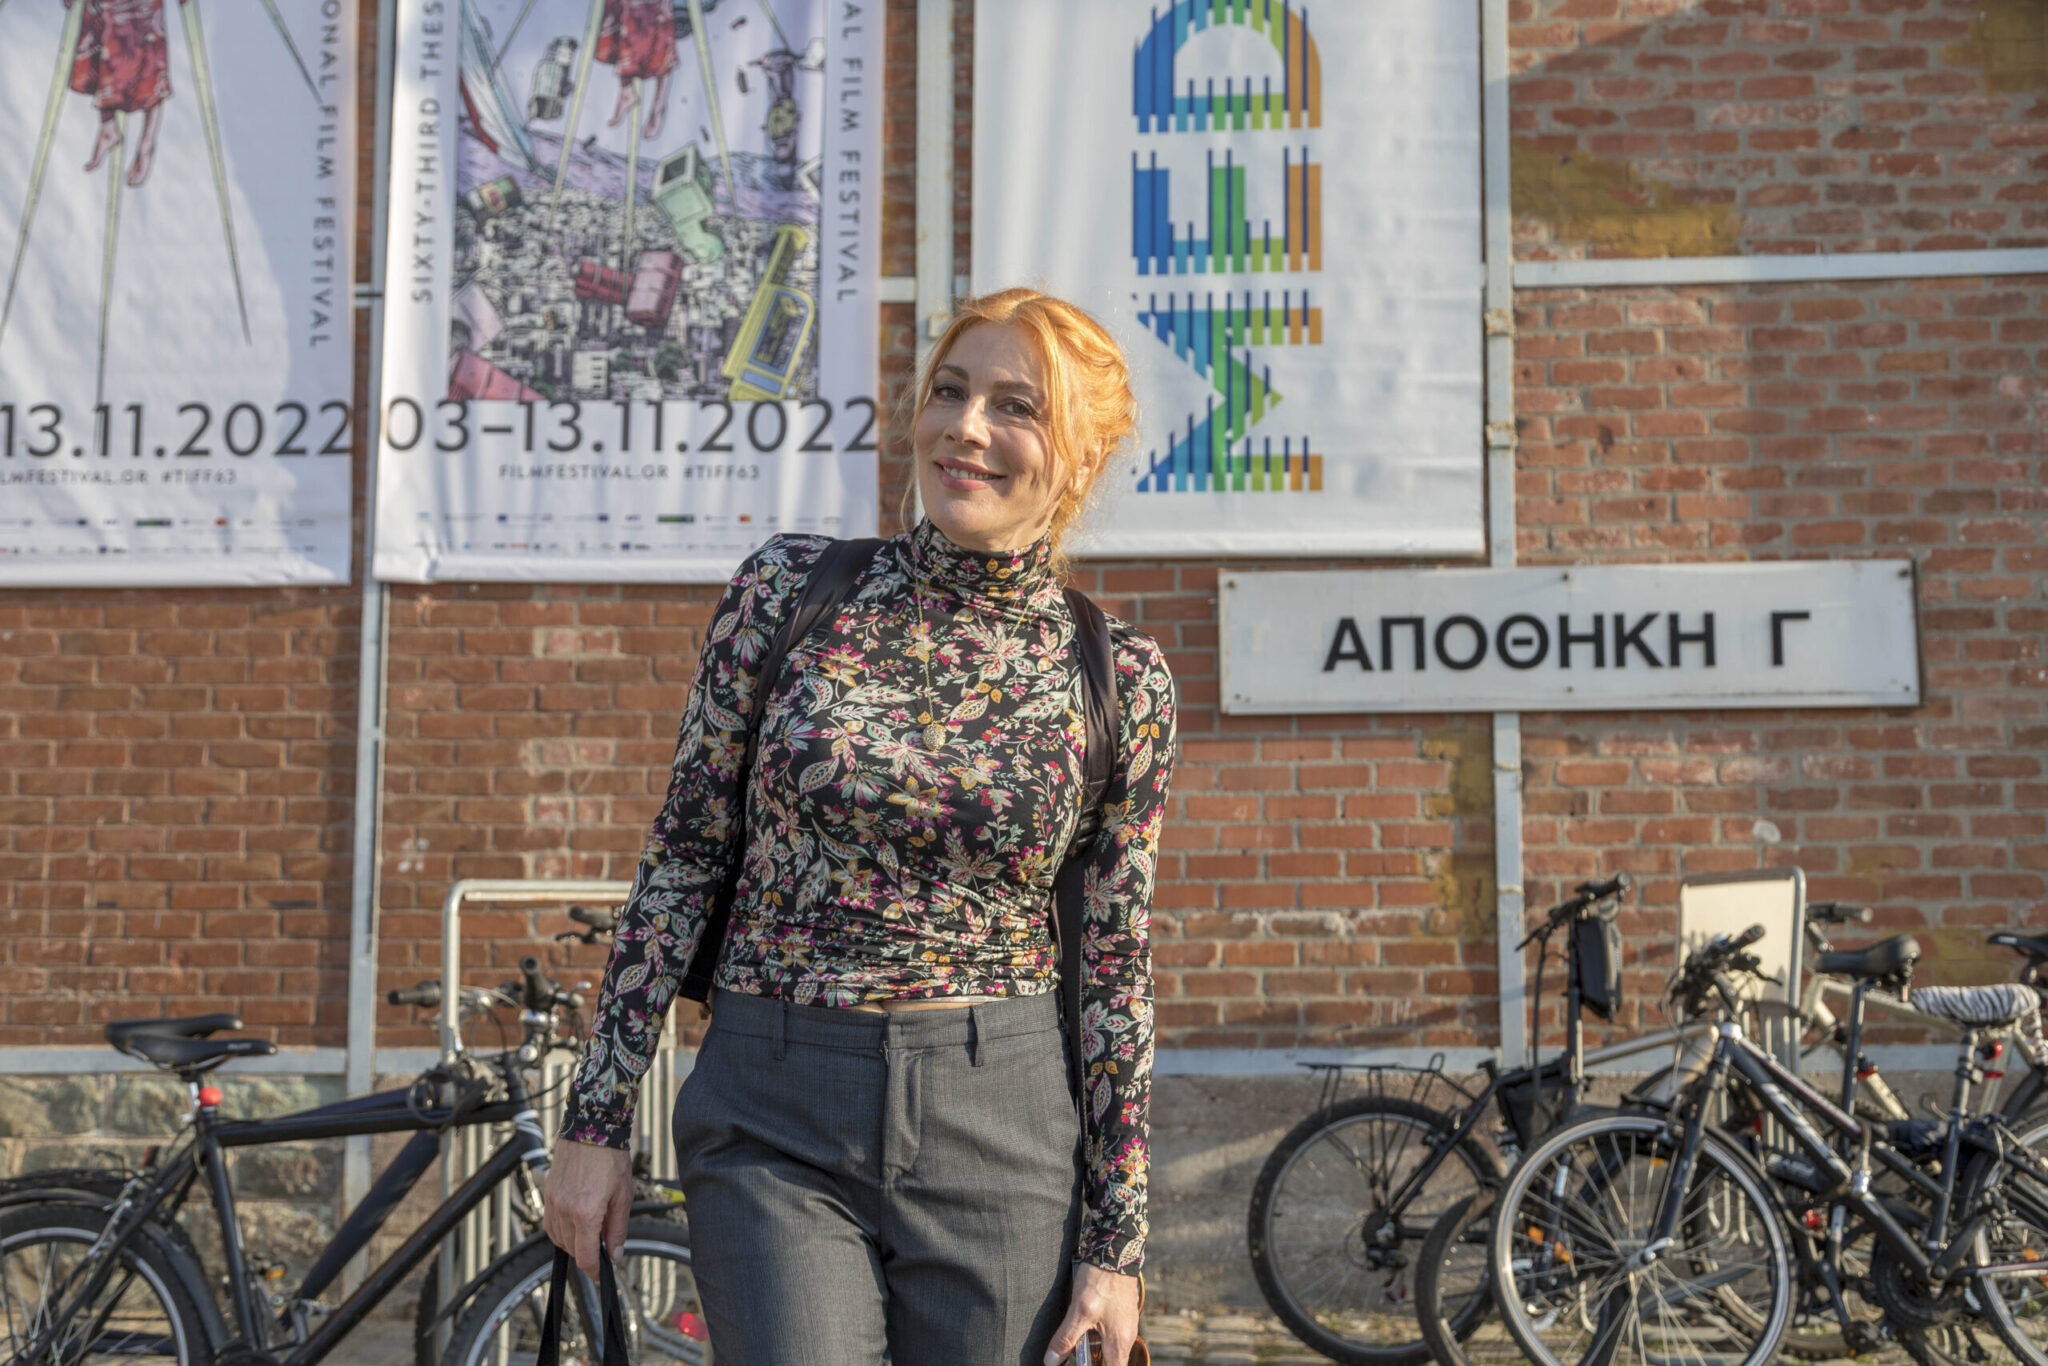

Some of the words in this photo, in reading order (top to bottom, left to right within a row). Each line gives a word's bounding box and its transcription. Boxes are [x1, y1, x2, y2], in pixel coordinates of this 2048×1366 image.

[421, 1, 444, 80] THES
[841, 0, 862, 40] AL
[841, 57, 862, 132] FILM
[316, 105, 338, 180] FILM
[412, 98, 440, 304] SIXTY-THIRD
[837, 150, 860, 302] FESTIVAL
[310, 197, 335, 348] FESTIVAL
[161, 468, 237, 485] #TIFF63
[499, 464, 669, 480] FILMFESTIVAL.GR
[683, 463, 760, 479] #TIFF63
[1322, 611, 1716, 672] ΑΠΟΘΗΚΗ
[1770, 610, 1811, 666] Γ
